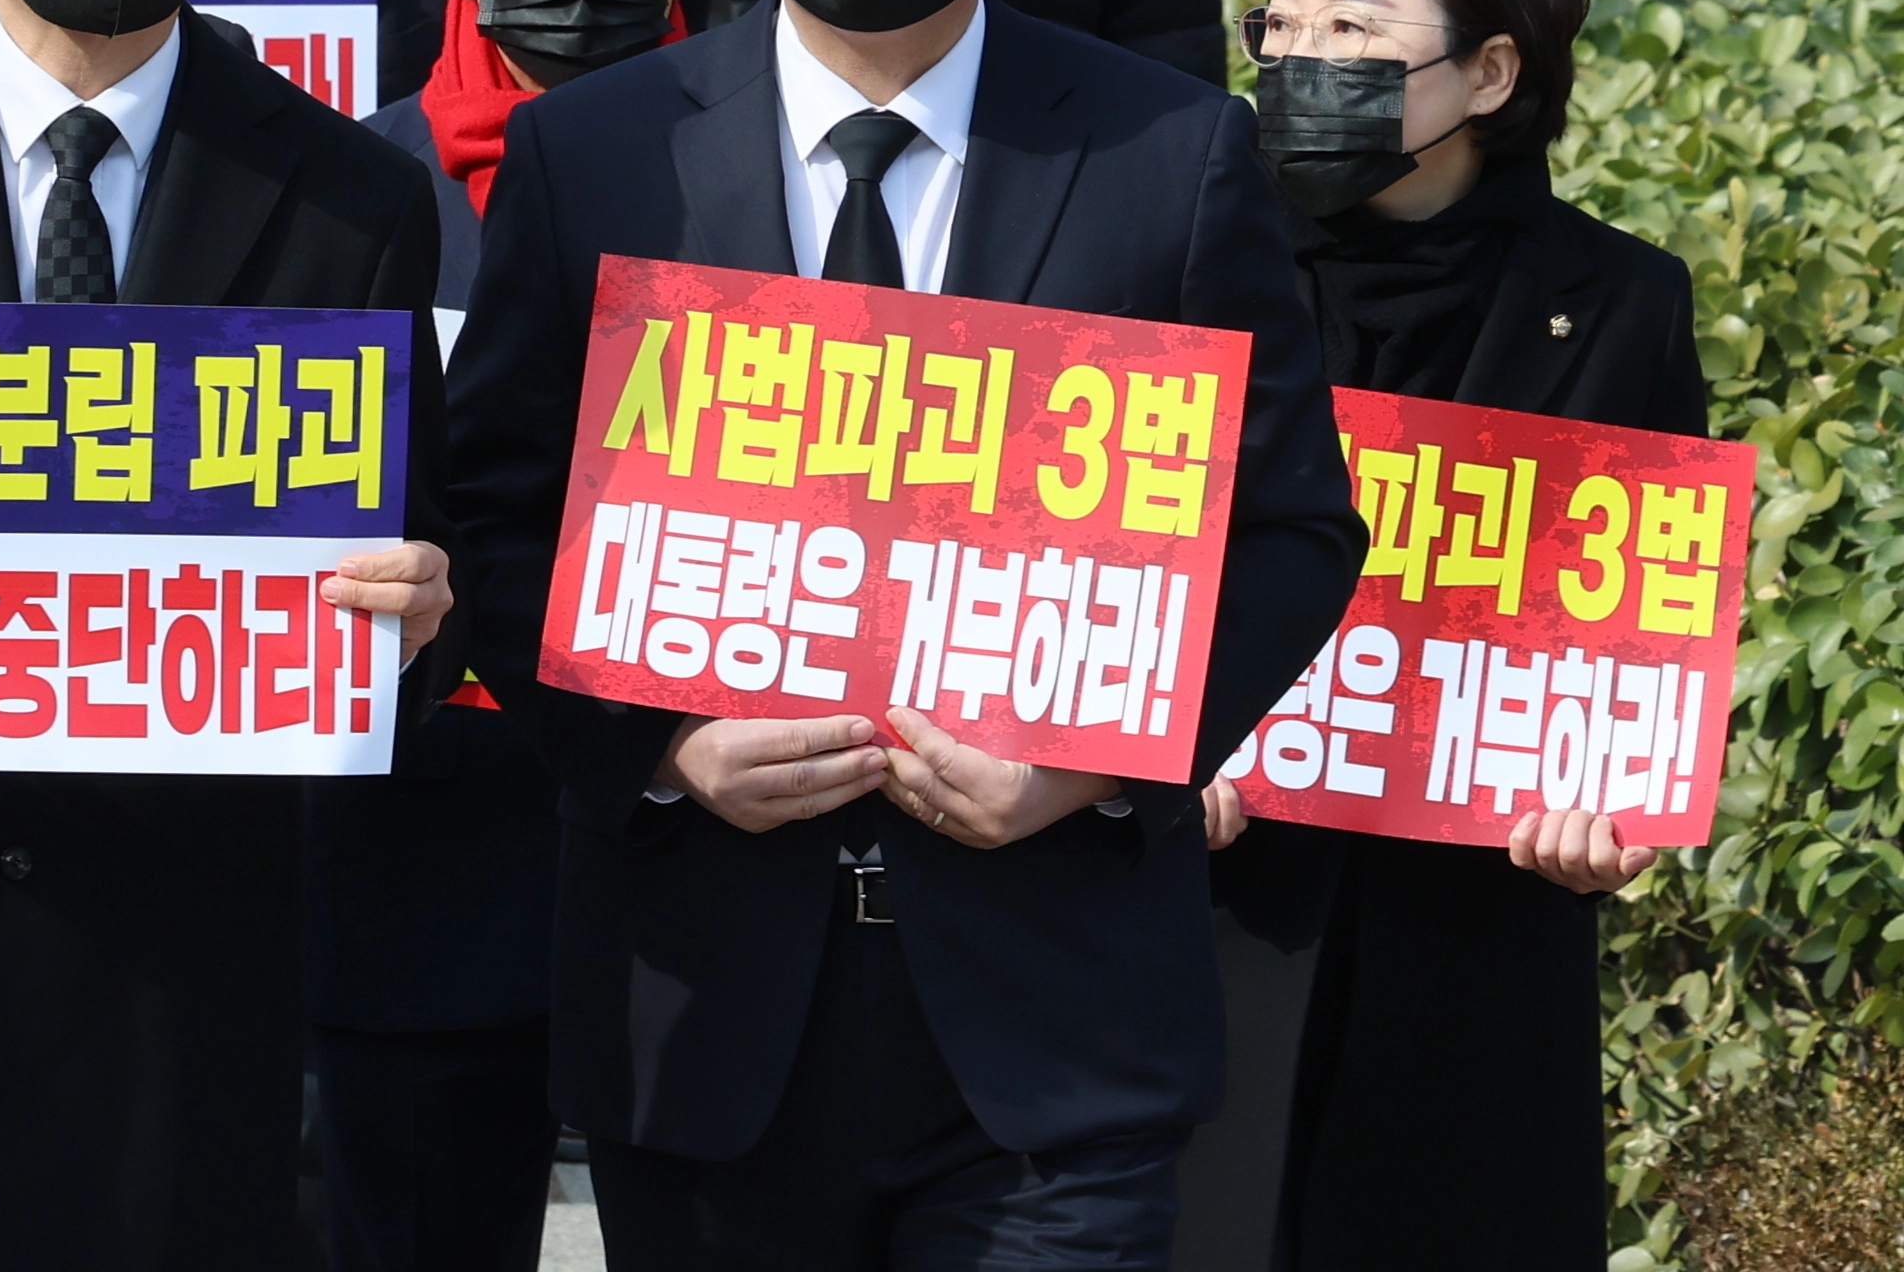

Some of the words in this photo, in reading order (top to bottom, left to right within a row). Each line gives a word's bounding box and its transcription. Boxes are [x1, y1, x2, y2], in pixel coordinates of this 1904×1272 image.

[188, 343, 386, 509] 파괴
[602, 310, 1015, 516] 사법파괴
[1035, 364, 1218, 538] 3법
[572, 500, 867, 702] 대통령은
[887, 538, 1190, 737] 거부하라!
[1557, 474, 1728, 638] 3법
[1420, 637, 1705, 815] 거부하라!
